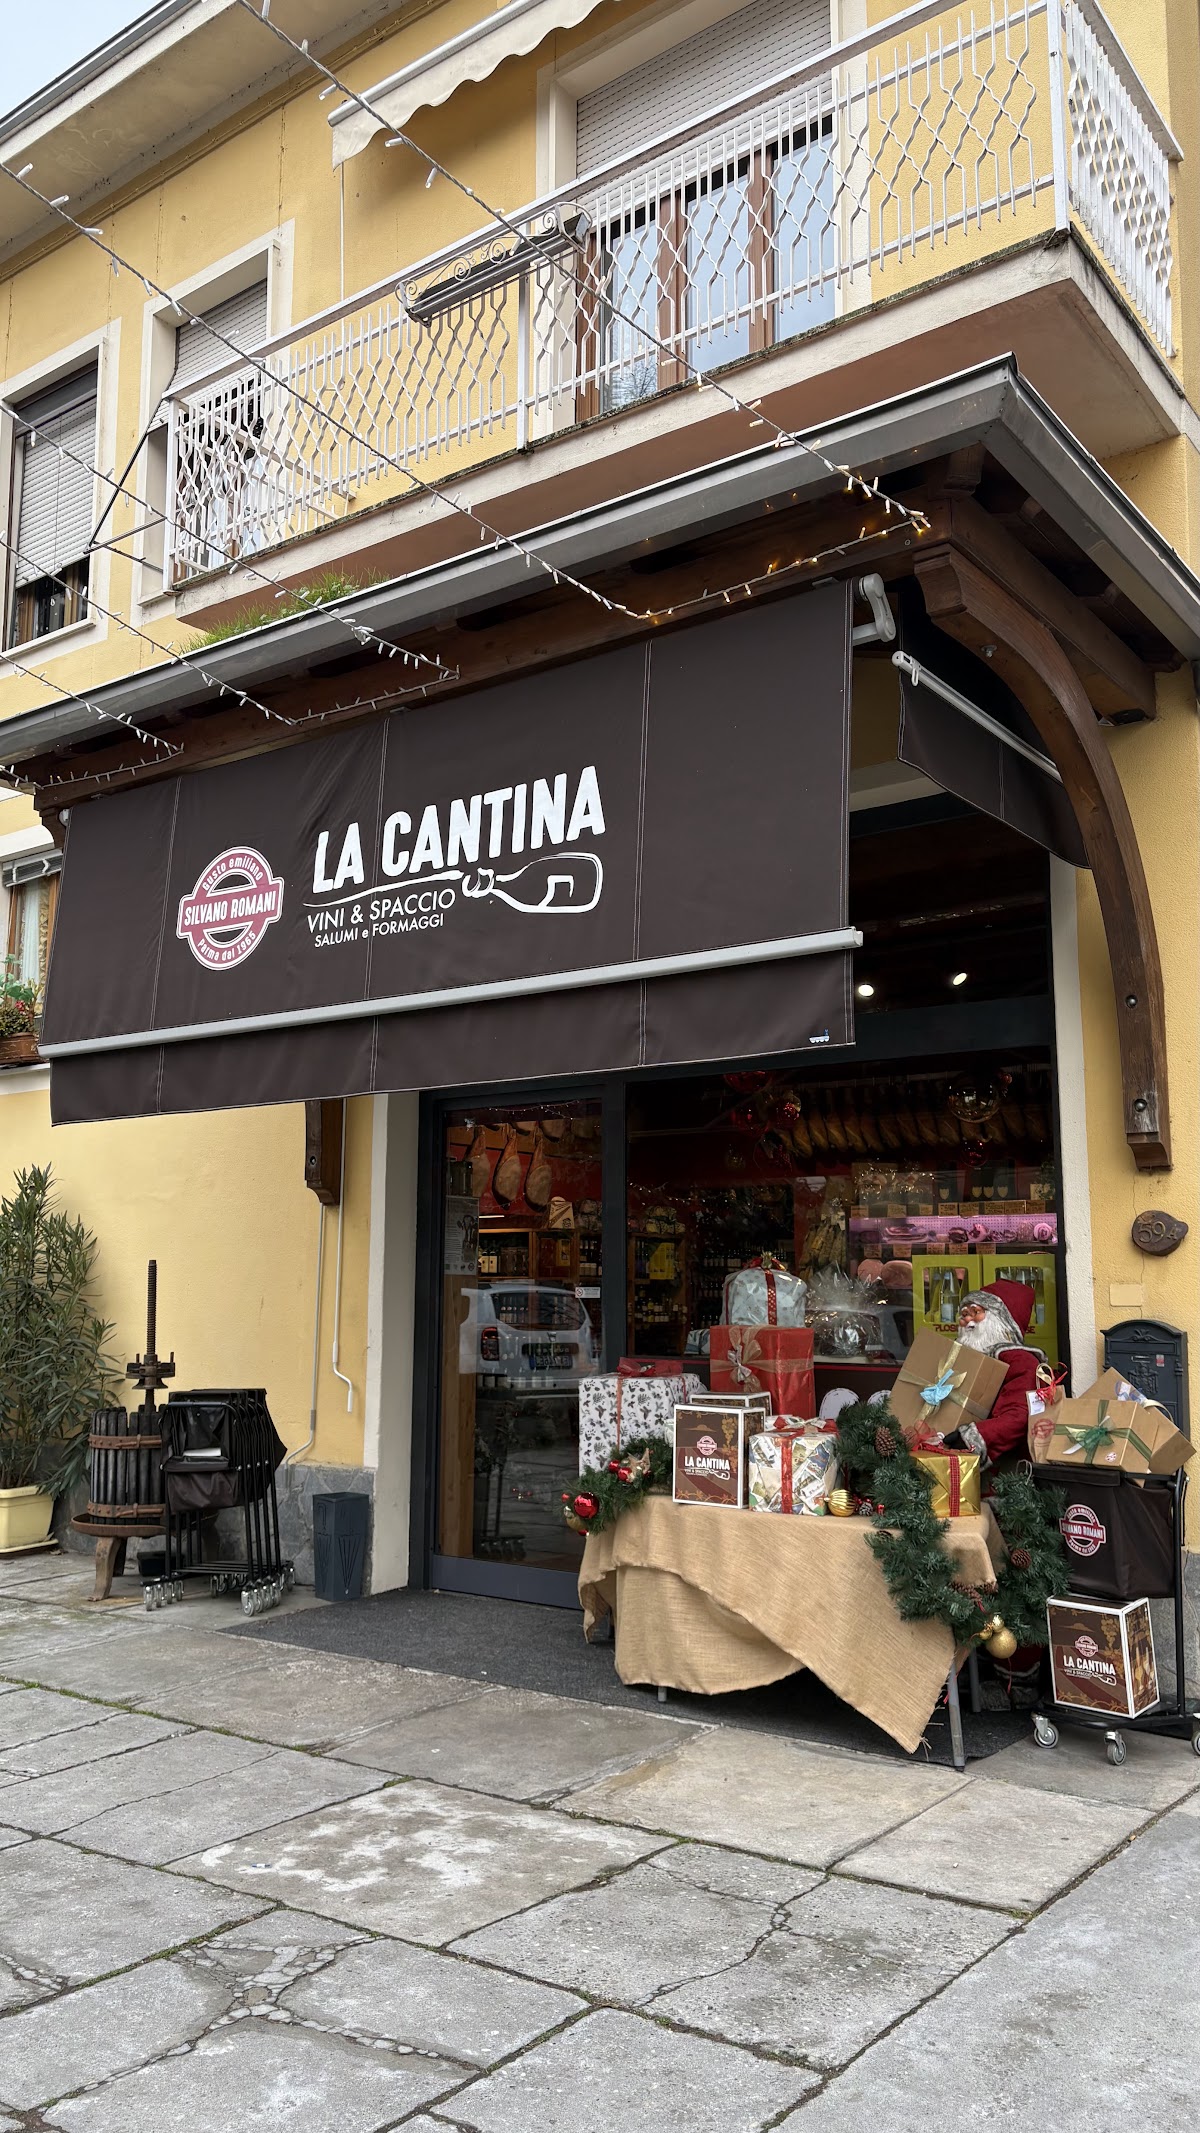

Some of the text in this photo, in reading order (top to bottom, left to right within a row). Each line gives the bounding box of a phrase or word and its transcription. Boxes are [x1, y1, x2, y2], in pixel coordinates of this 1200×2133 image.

[312, 765, 605, 893] LA CANTINA
[202, 855, 264, 890] Gusto emiliano
[184, 890, 276, 926] SILVANO ROMANI
[307, 888, 456, 933] VINI & SPACCIO
[197, 930, 256, 961] Parma dal 1965
[314, 913, 444, 948] SALUMI e FORMAGGI
[1137, 1219, 1166, 1244] 59
[685, 1456, 730, 1471] LA CANTINA
[1082, 1525, 1104, 1540] ROMANI
[1063, 1654, 1075, 1668] LA
[1076, 1657, 1116, 1676] CANTINA
